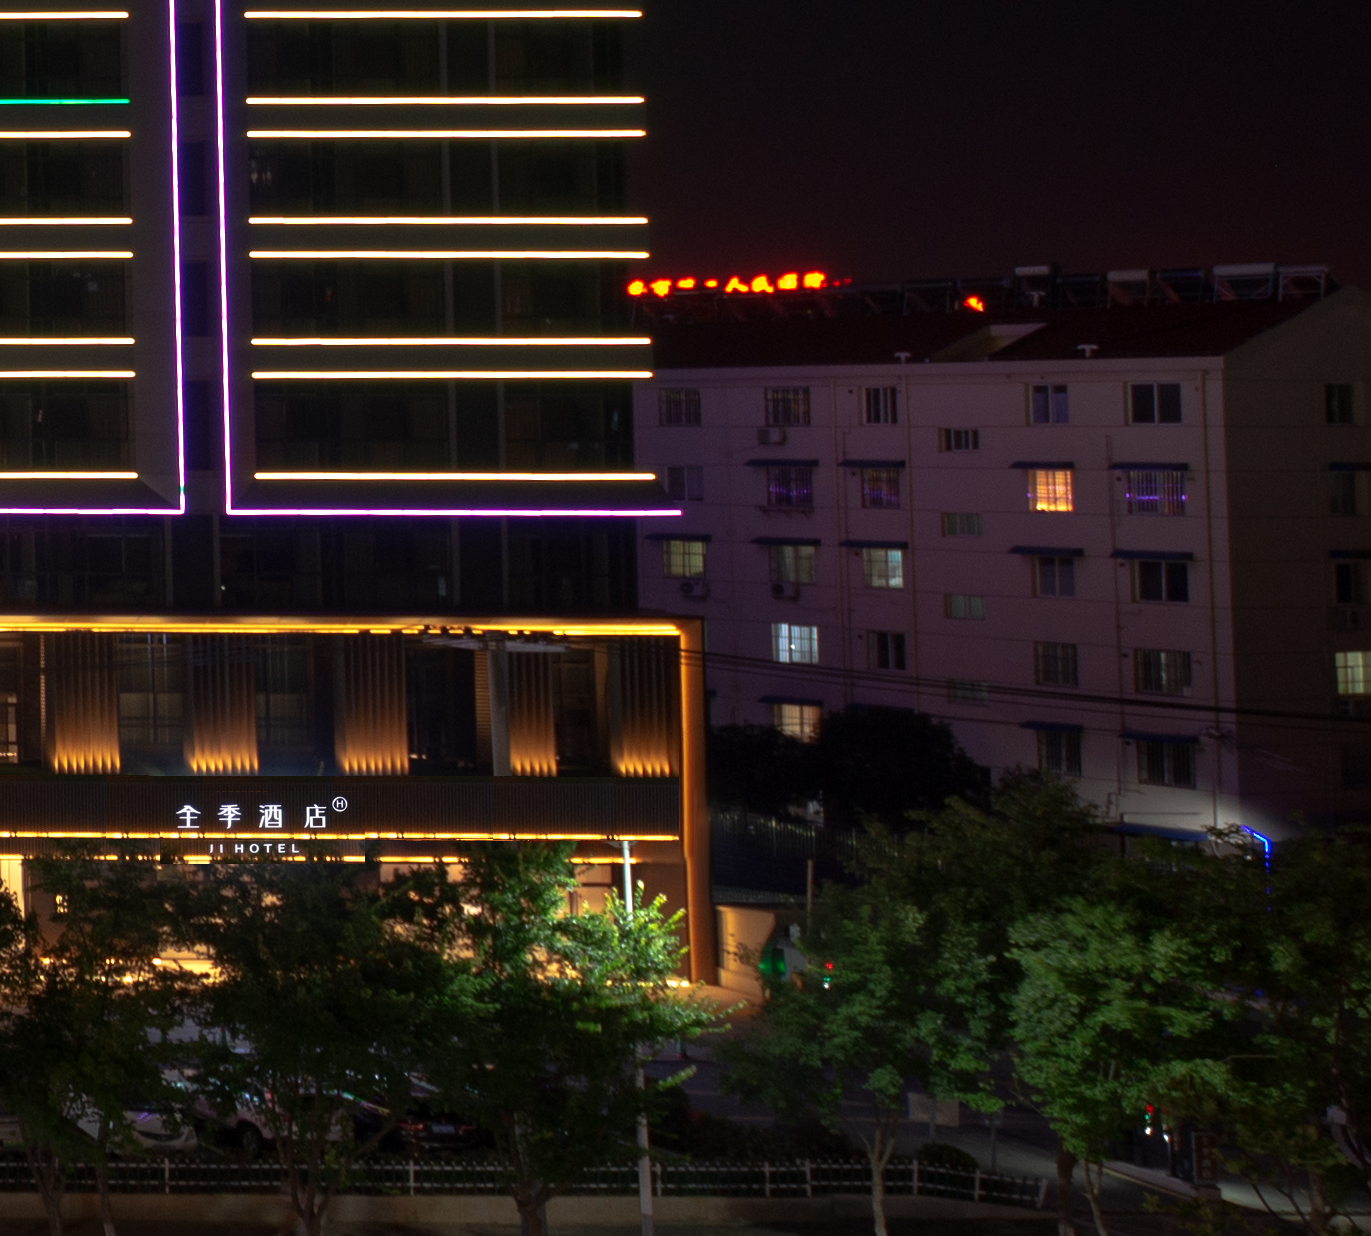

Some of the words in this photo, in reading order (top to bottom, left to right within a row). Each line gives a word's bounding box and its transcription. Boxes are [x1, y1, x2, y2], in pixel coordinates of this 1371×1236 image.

[176, 804, 327, 830] 全季酒店
[210, 844, 224, 853] JI
[234, 844, 299, 853] HOTEL
